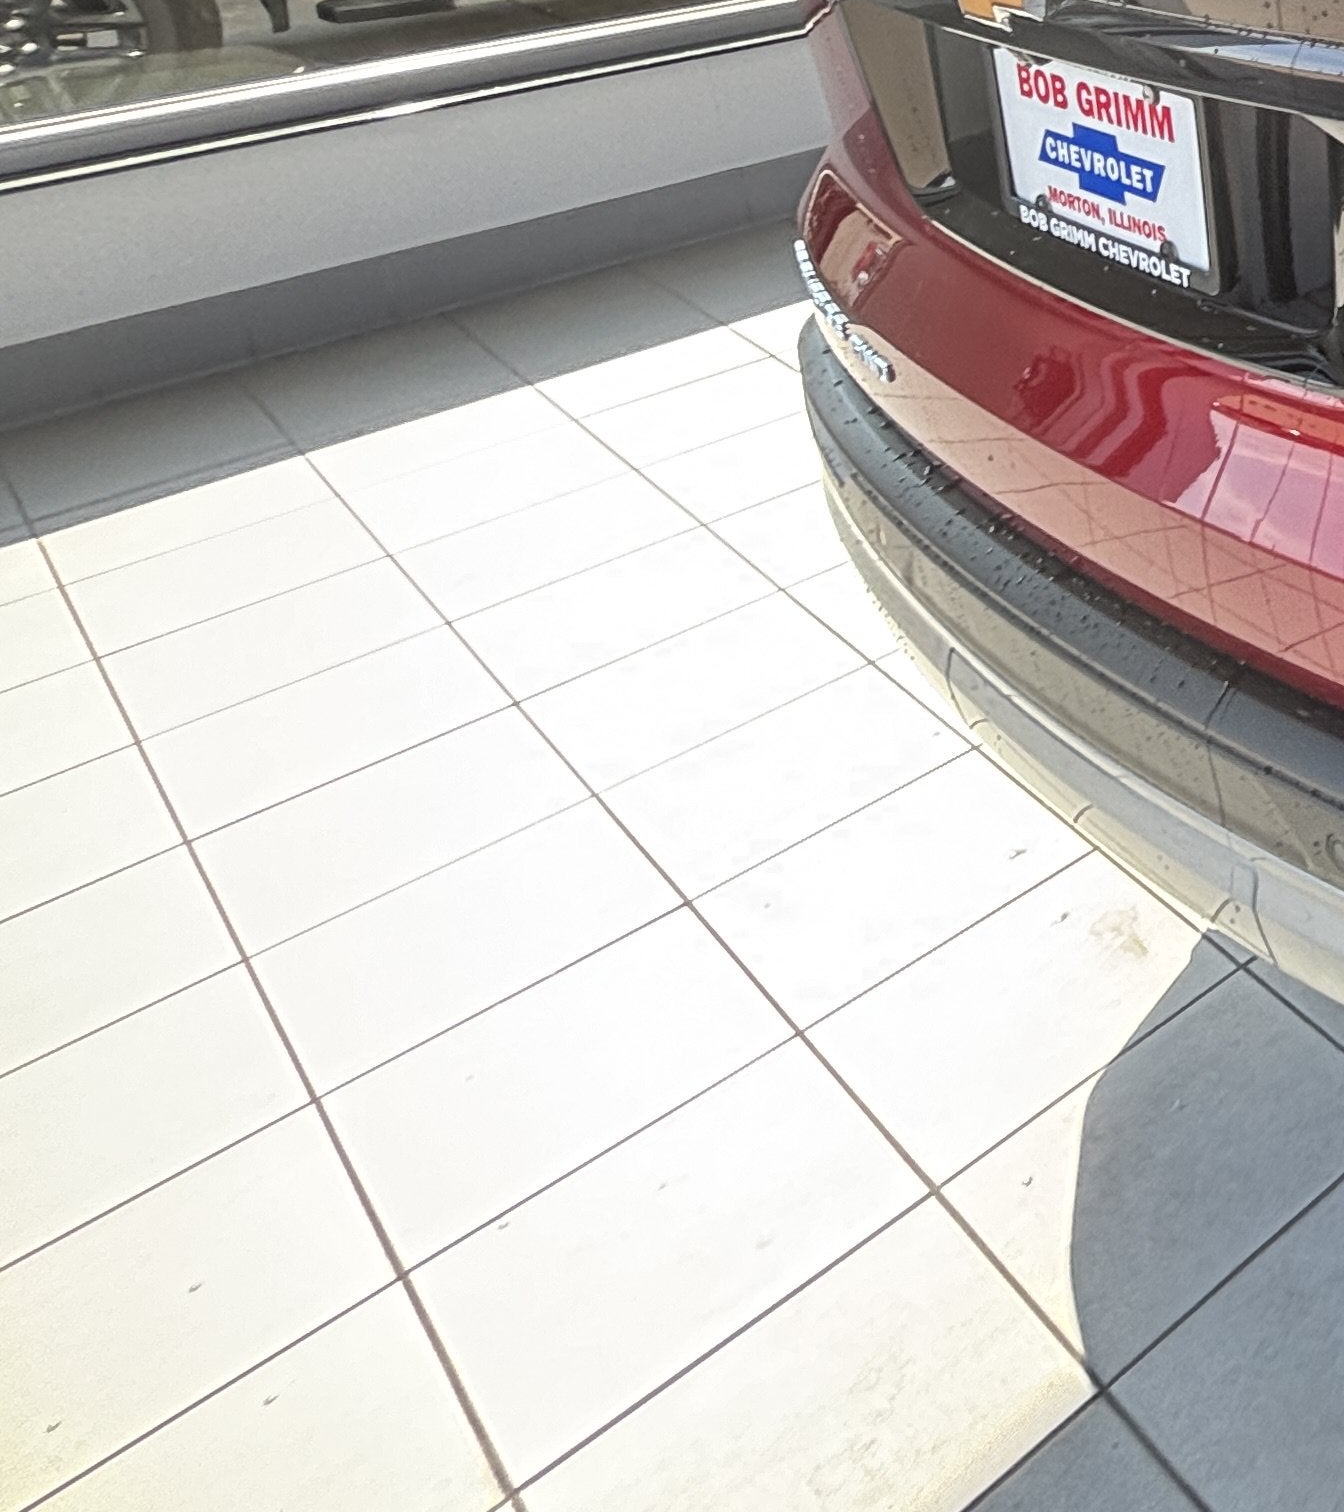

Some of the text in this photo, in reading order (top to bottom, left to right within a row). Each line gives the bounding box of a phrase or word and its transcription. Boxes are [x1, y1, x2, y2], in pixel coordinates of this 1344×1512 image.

[1016, 63, 1176, 143] BOB GRIMM
[1044, 137, 1155, 193] CHEVROLET
[1019, 204, 1191, 288] BOB GRIMM CHEVROLET
[1047, 185, 1168, 243] MORTON, ILLINOIS
